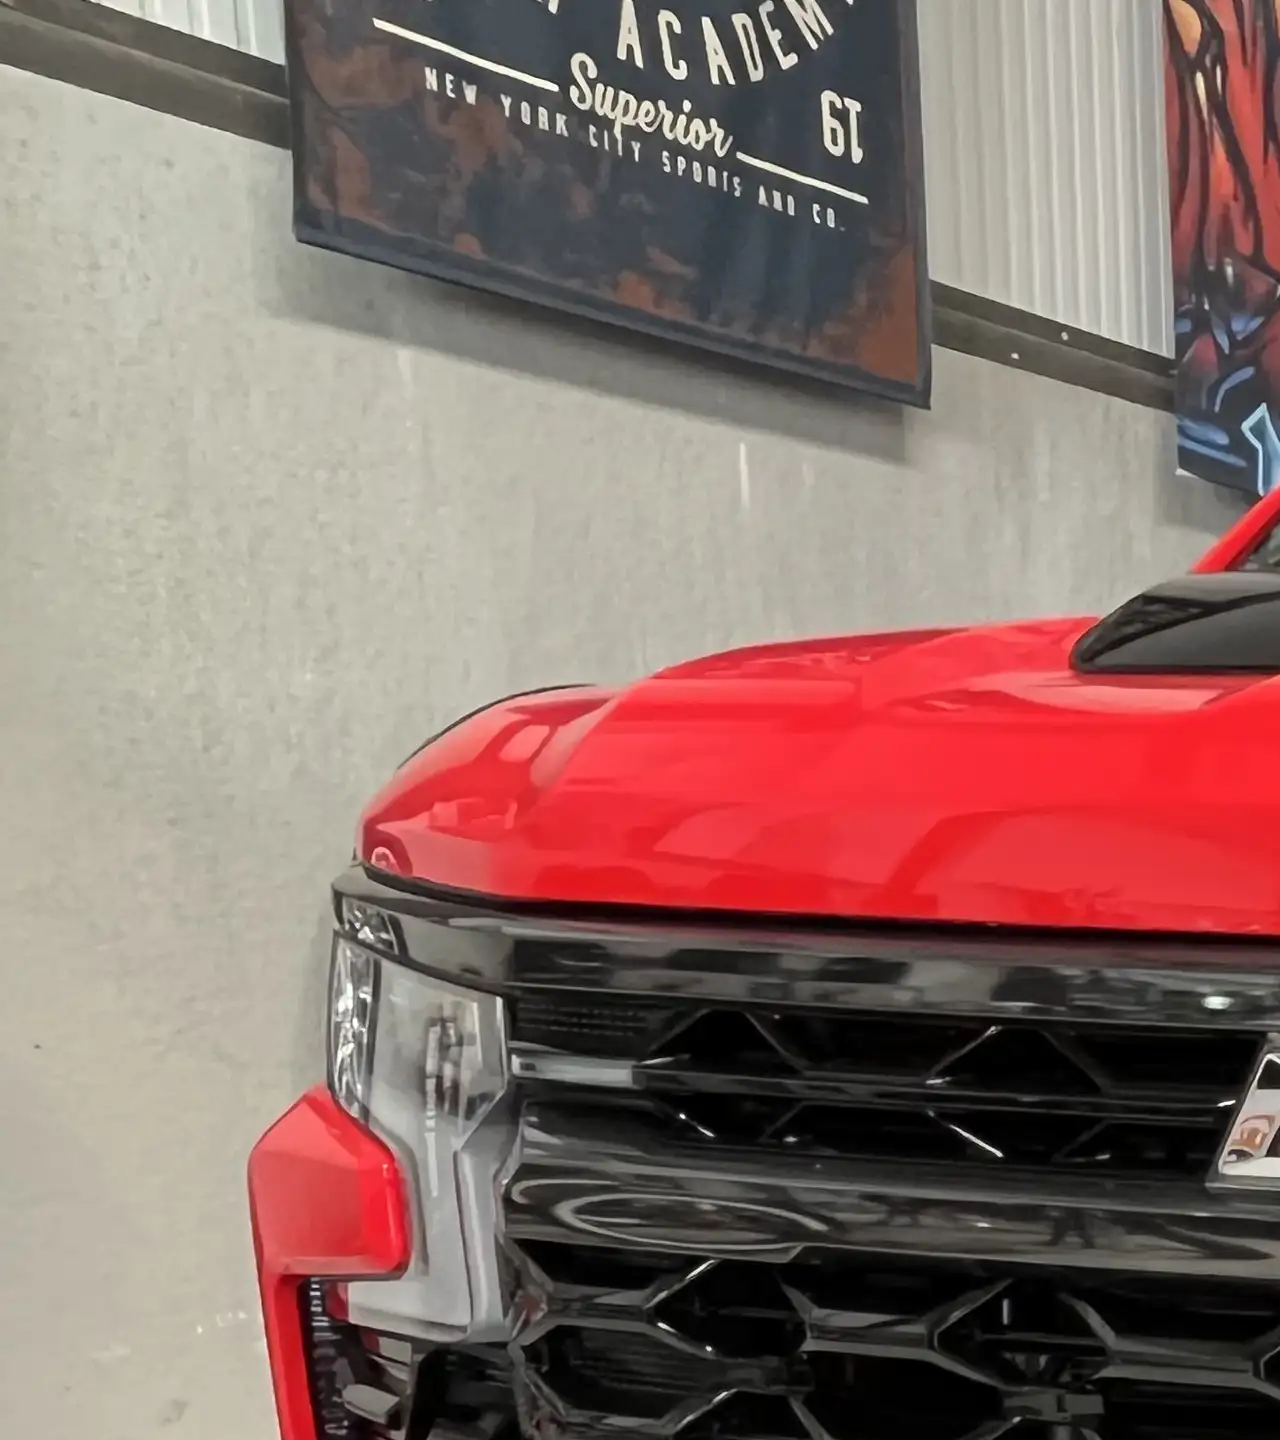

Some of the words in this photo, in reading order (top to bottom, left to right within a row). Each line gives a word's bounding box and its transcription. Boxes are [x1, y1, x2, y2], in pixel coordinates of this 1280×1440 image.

[616, 0, 854, 86] ACADEM
[424, 66, 478, 106] NEW
[500, 93, 570, 138] YORK
[588, 123, 642, 163] CITY
[661, 150, 742, 198] SPORTS
[758, 184, 796, 217] AND
[570, 52, 734, 158] Superior
